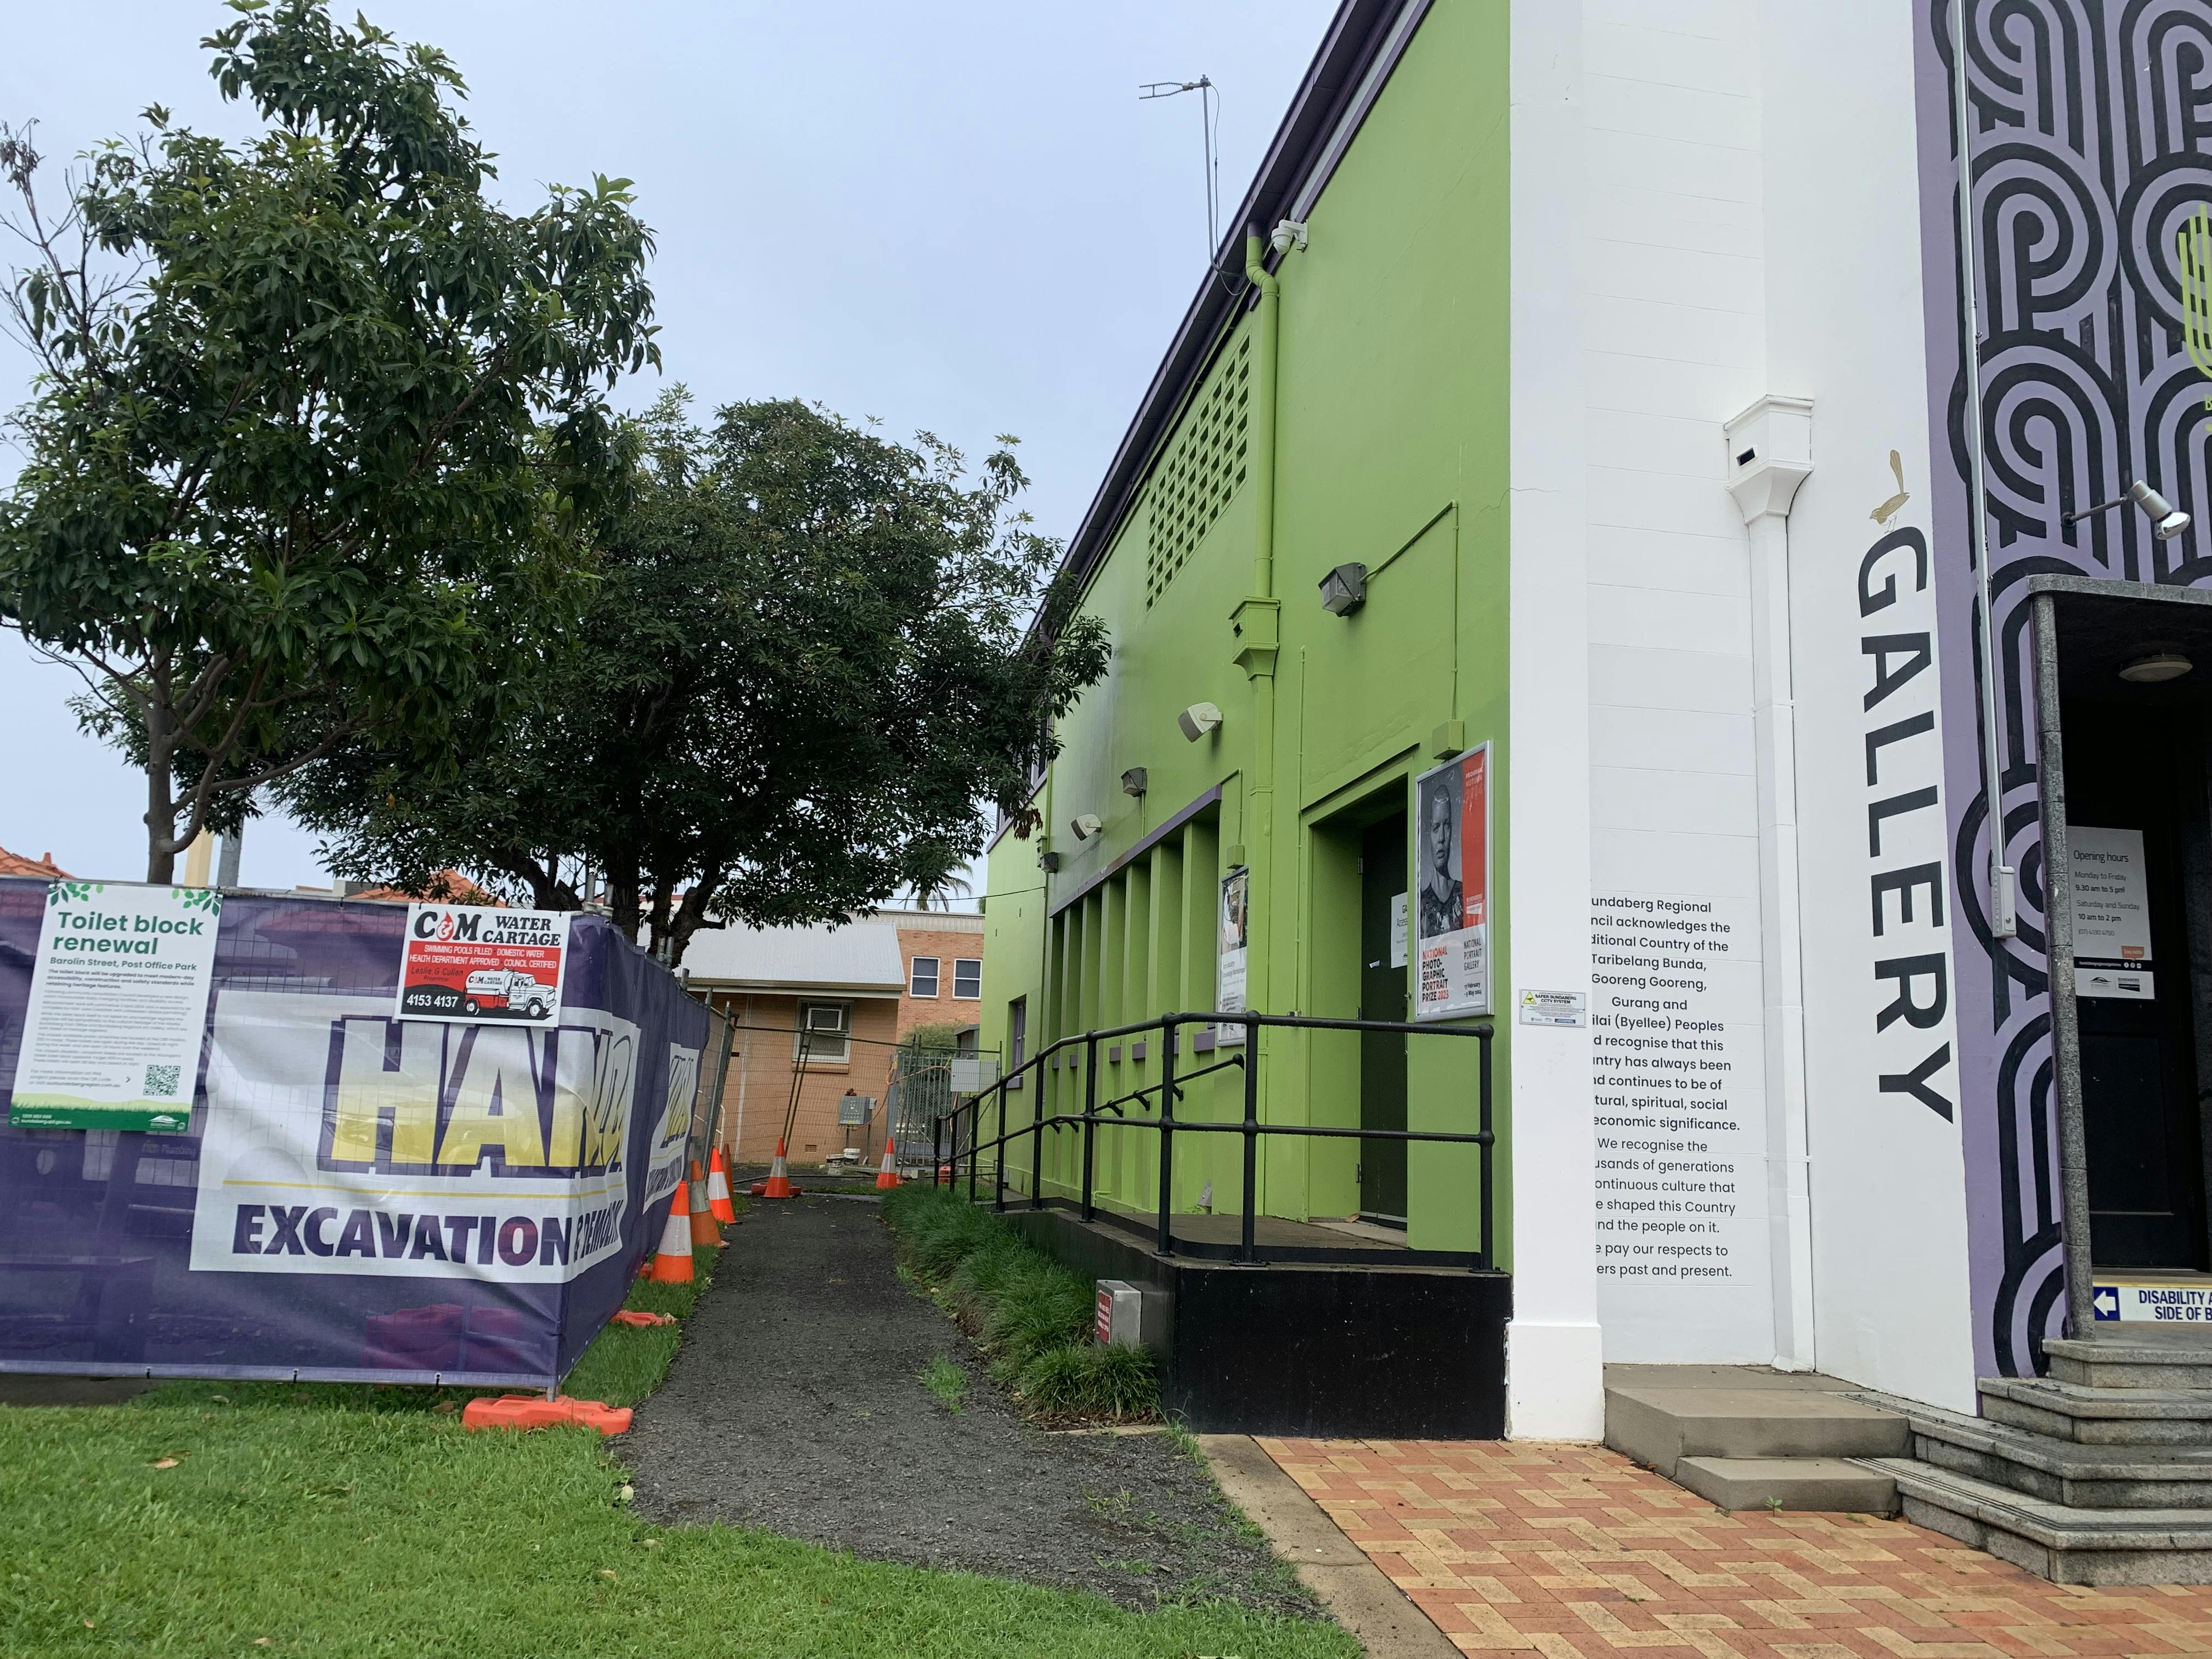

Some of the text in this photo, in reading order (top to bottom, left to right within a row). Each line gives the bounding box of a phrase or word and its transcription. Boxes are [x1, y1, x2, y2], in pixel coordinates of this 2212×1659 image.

[1858, 526, 1954, 1126] GALLERY
[2073, 850, 2129, 864] Opening hours
[2075, 871, 2099, 880] Monday
[2108, 873, 2126, 881] Friday
[1592, 897, 1711, 914] undaberg Regional
[2076, 900, 2103, 909] Saturday
[2117, 902, 2140, 911] Sunday
[58, 911, 204, 936] Toilet block
[414, 910, 482, 941] C&M
[496, 916, 551, 931] WATER
[1591, 916, 1730, 934] ncil acknowledges the
[52, 934, 159, 955] renewal
[482, 930, 561, 946] CARTAGE
[1464, 938, 1481, 949] NATIONAL
[1639, 938, 1690, 952] Country
[1694, 940, 1706, 950] of
[1708, 941, 1729, 951] the
[424, 945, 452, 953] SWIMMING
[453, 946, 472, 955] POOLS
[473, 947, 492, 955] FILLED
[497, 949, 524, 957] DOMESTIC
[1423, 946, 1447, 960] NATIONAL
[1464, 949, 1482, 960] PORTRAIT
[50, 956, 197, 972] Barolin Street, Post Office Park
[432, 956, 469, 964] DEPARTMENT
[470, 958, 499, 966] APPROVED
[529, 961, 556, 969] CERTIFIED
[1423, 958, 1442, 970] PHOTO-
[1464, 960, 1480, 970] GALLERY
[1592, 954, 1707, 972] Taribelang Bunda,
[1423, 968, 1444, 981] GRAPHIC
[1423, 979, 1448, 991] PORTRAIT
[1592, 974, 1707, 992] Gooreng Gooreng,
[407, 994, 458, 1008] 4153 4137
[1423, 989, 1449, 1002] PRIZE 2023
[1612, 997, 1687, 1012] Gurang and
[1615, 1014, 1671, 1031] (Byellee)
[1675, 1020, 1724, 1034] Peoples
[1606, 1036, 1668, 1050] recognise
[1672, 1039, 1697, 1049] that
[1701, 1040, 1724, 1051] this
[1625, 1057, 1648, 1067] has
[1651, 1058, 1696, 1072] always
[1700, 1059, 1731, 1071] been
[1609, 1076, 1672, 1088] continues
[1675, 1079, 1687, 1088] to
[1691, 1079, 1707, 1089] be
[1710, 1079, 1722, 1090] of
[1595, 1095, 1727, 1110] tural, spiritual, social
[1594, 1116, 1740, 1132] economic significance.
[1598, 1138, 1707, 1153] We recognise the
[1643, 1160, 1655, 1170] of
[1658, 1161, 1734, 1174] generations
[1662, 1181, 1706, 1192] culture
[1709, 1182, 1735, 1193] that
[1607, 1199, 1655, 1214] shaped
[1659, 1200, 1681, 1211] this
[1685, 1201, 1735, 1216] Country
[232, 1203, 574, 1267] EXCAVATION
[1618, 1220, 1719, 1235] the people on it.
[1605, 1244, 1728, 1258] pay our respects to
[1597, 1265, 1733, 1279] ers past and present.
[2139, 1290, 2205, 1305] DISABILITY
[2155, 1306, 2202, 1320] SIDE OF
